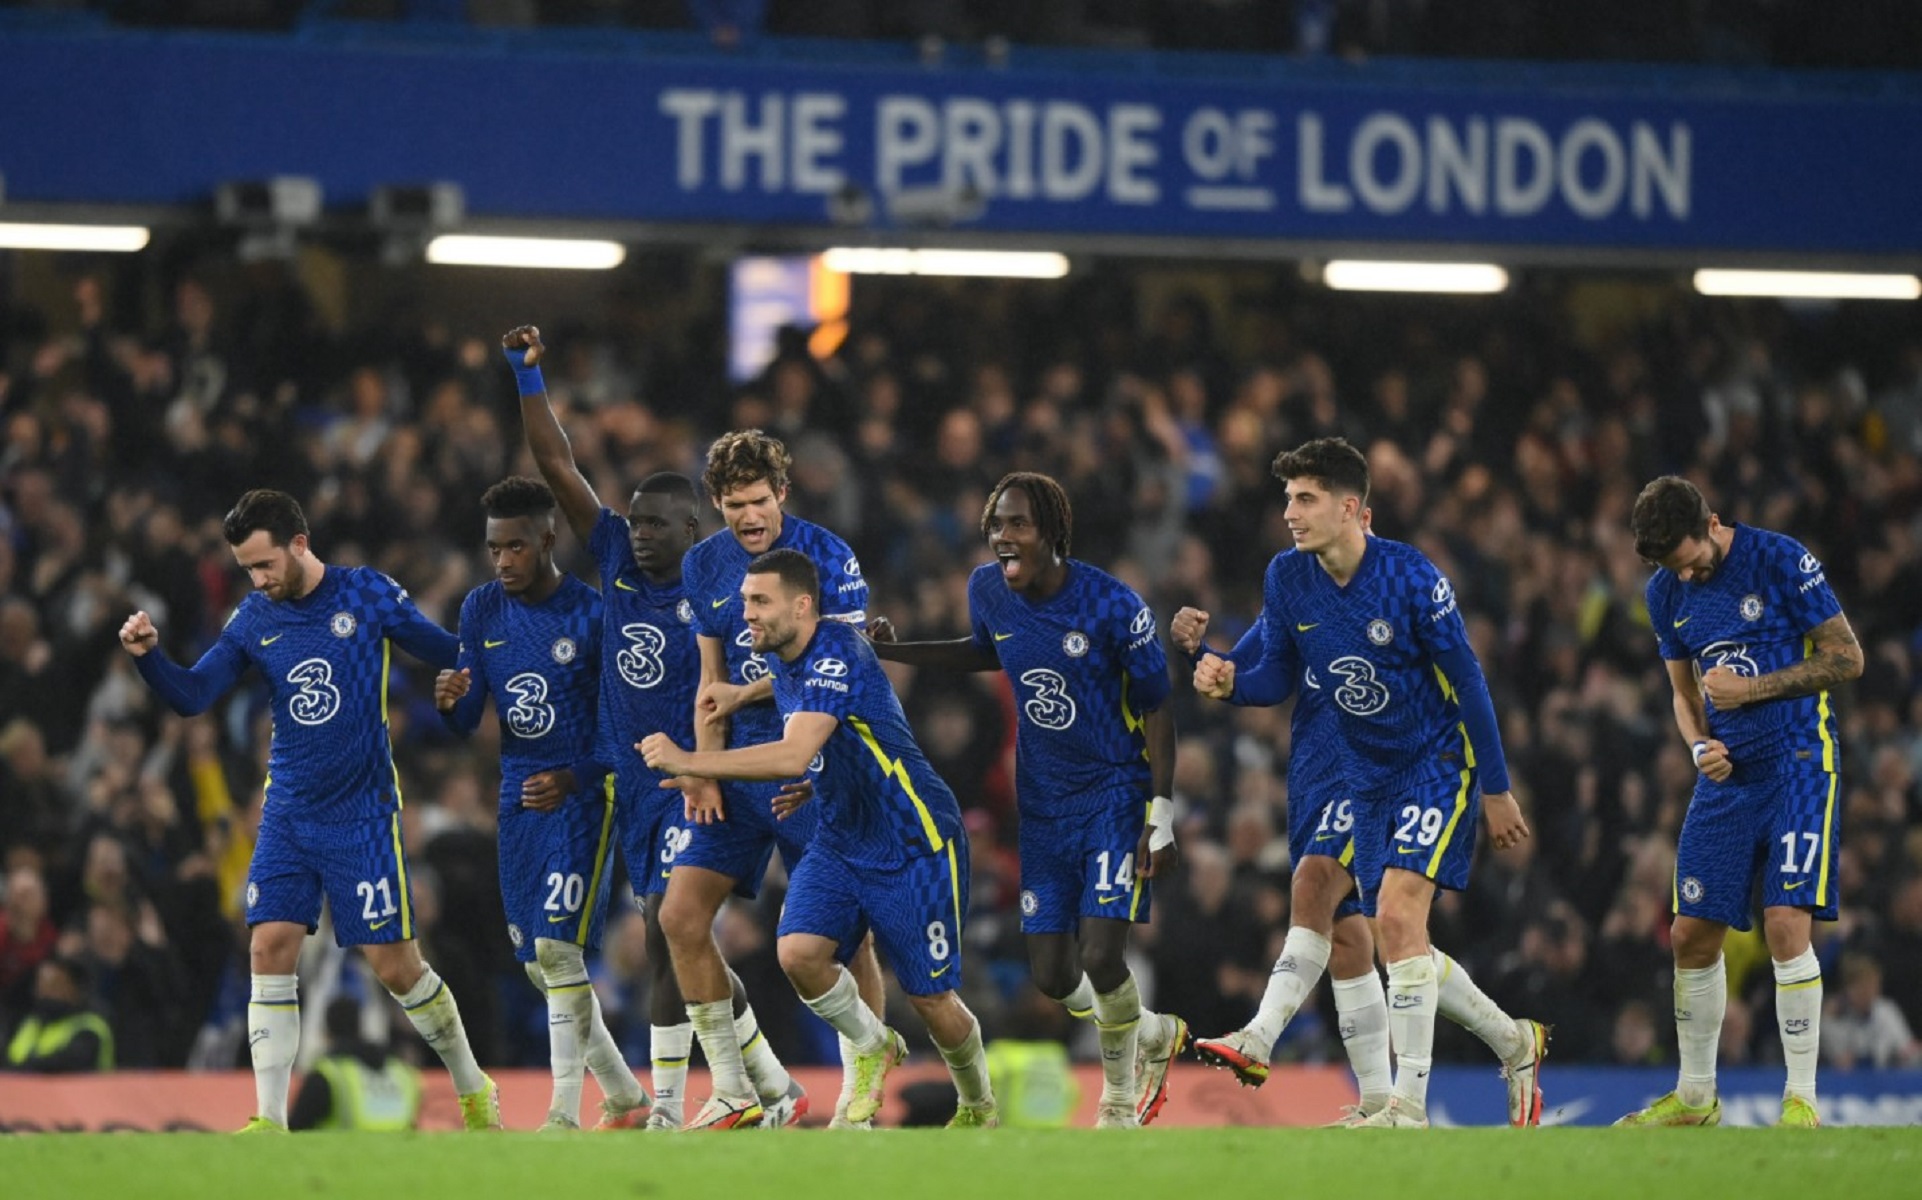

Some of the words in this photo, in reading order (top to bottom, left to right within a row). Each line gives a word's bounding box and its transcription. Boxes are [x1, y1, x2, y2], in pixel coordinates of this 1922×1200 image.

[659, 89, 847, 192] THE
[876, 95, 1163, 203] PRIDE
[1182, 109, 1277, 180] OF
[1299, 112, 1691, 221] LONDON
[616, 622, 666, 690] 3
[287, 657, 351, 725] 3
[505, 672, 556, 739] 3
[1020, 667, 1076, 731] 3
[1328, 655, 1390, 716] 3
[1315, 799, 1355, 834] 19
[1394, 804, 1443, 847] 29
[1094, 851, 1134, 895] 14
[1780, 831, 1820, 875] 17
[357, 877, 397, 920] 21
[544, 872, 585, 913] 20
[927, 920, 950, 961] 8
[1394, 994, 1423, 1003] CFC
[1785, 1018, 1810, 1027] CFC
